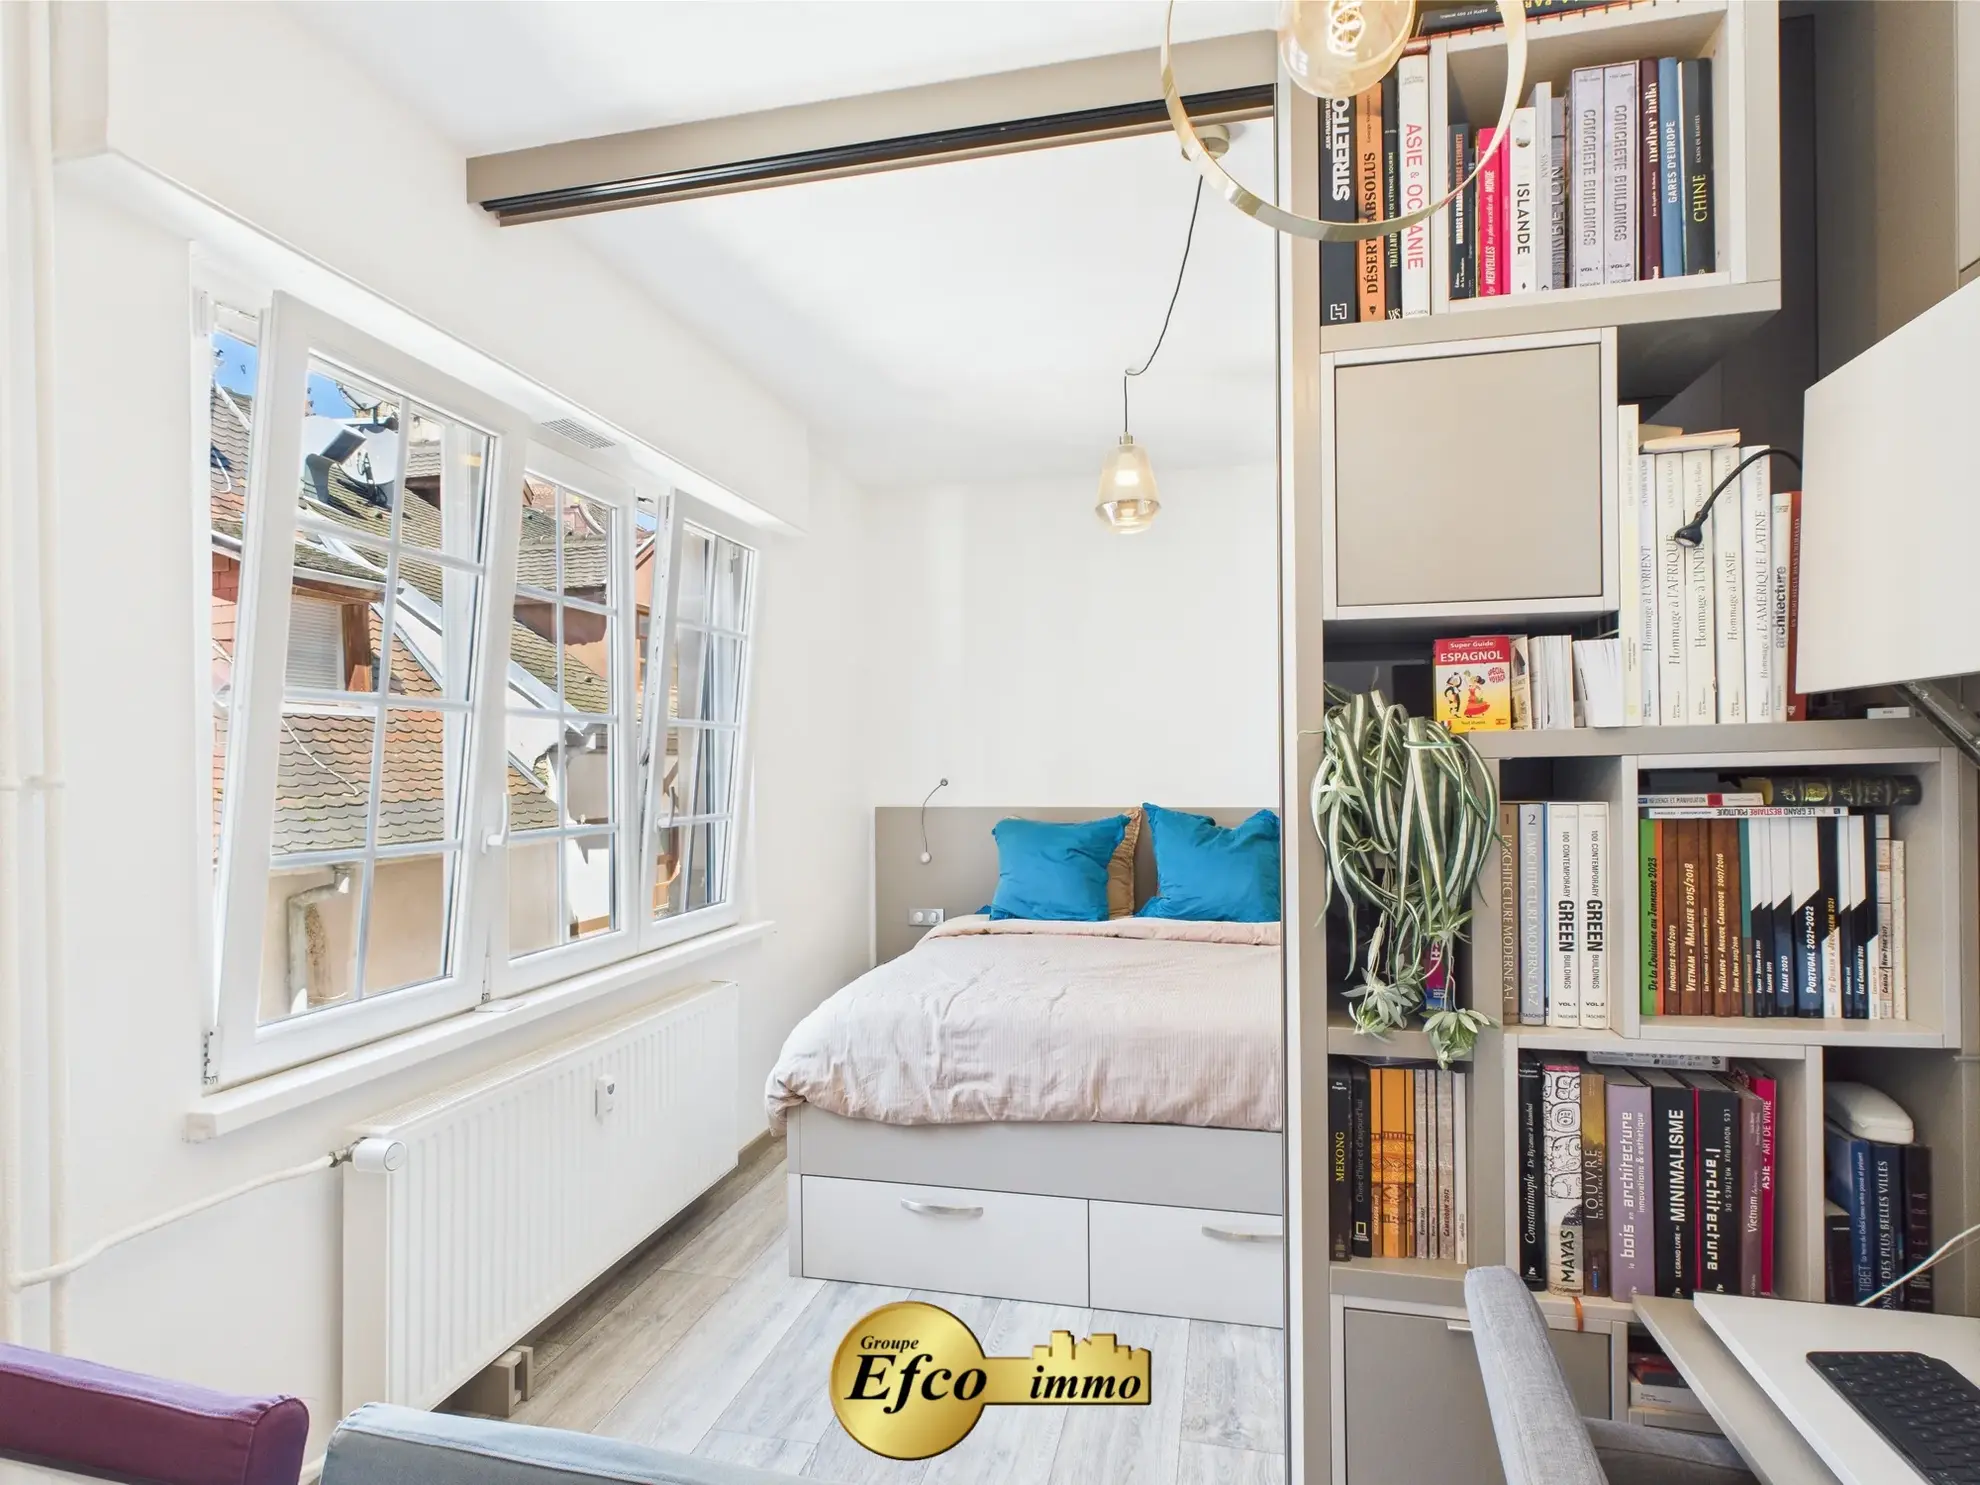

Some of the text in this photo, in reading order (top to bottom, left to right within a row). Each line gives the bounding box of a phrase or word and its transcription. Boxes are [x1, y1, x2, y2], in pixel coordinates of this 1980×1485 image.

[1406, 124, 1423, 167] ASIE
[1645, 82, 1659, 163] mother india
[1583, 109, 1596, 246] CONCRETE BUILDINGS
[1613, 105, 1627, 241] CONCRETE BUILDINGS
[1666, 121, 1677, 203] GARES D'EUROPE
[1517, 183, 1530, 255] ISLANDE
[1692, 174, 1707, 222] CHINE
[1407, 184, 1424, 270] OCANIE
[1484, 170, 1495, 284] MERVEILLES MONDE
[1754, 510, 1766, 554] LATINE
[1725, 552, 1737, 584] L'ASIE
[1640, 546, 1654, 652] Hommage L'ORIENT
[1694, 594, 1707, 647] Hommage
[1727, 592, 1739, 640] Hommage
[1753, 557, 1768, 632] L'AMÉRIQUE
[1772, 567, 1787, 649] architecture
[1440, 650, 1504, 662] ESPAGNOL
[1472, 640, 1494, 648] Guide
[1668, 611, 1682, 665] Hommage
[1759, 641, 1769, 678] Hommage
[1528, 814, 1536, 825] 2
[1716, 808, 1748, 816] POLITIQUE
[1750, 808, 1782, 816] BESTIAIRE
[1562, 843, 1571, 897] CONTEMPORARY
[1591, 843, 1599, 897] CONTEMPORARY
[1526, 833, 1538, 1007] L'ARCHITECTURE MODERNE M-Z
[1559, 900, 1575, 952] GREEN
[1587, 900, 1603, 952] GREEN
[1648, 857, 1658, 990] De la Louisiane au Tennessee 2023
[1684, 863, 1696, 992] VIETNAM MALAISIE 2015/2018
[1717, 927, 1726, 952] ANGKOR
[1502, 926, 1514, 981] MODERNE
[1563, 954, 1571, 989] BUILDINGS
[1592, 954, 1600, 989] BUILDINGS
[1805, 906, 1817, 993] PORTUGAL 2021-2022
[1503, 984, 1513, 1002] A-L
[1780, 974, 1789, 993] ITALIE
[1763, 1100, 1772, 1125] VIVRE
[1763, 1127, 1771, 1136] DE
[1335, 1132, 1345, 1182] MEKONG
[1355, 1099, 1365, 1202] Chine d'hier et d'aujourd'hui
[1619, 1112, 1634, 1208] architecture
[1668, 1109, 1686, 1222] MINIMALISME
[1584, 1149, 1598, 1219] LOUVRE
[1637, 1166, 1645, 1213] innovations
[1762, 1166, 1770, 1189] ASIE
[1524, 1174, 1537, 1243] Constantinople
[1705, 1148, 1721, 1270] l'architecture
[1725, 1203, 1732, 1212] DE
[1748, 1196, 1758, 1233] Vietnam
[1878, 1161, 1891, 1279] DES PLUS BELLES VILLES
[1560, 1230, 1575, 1283] MAYAS
[1620, 1225, 1635, 1259] bois
[1858, 1265, 1872, 1292] TIBET
